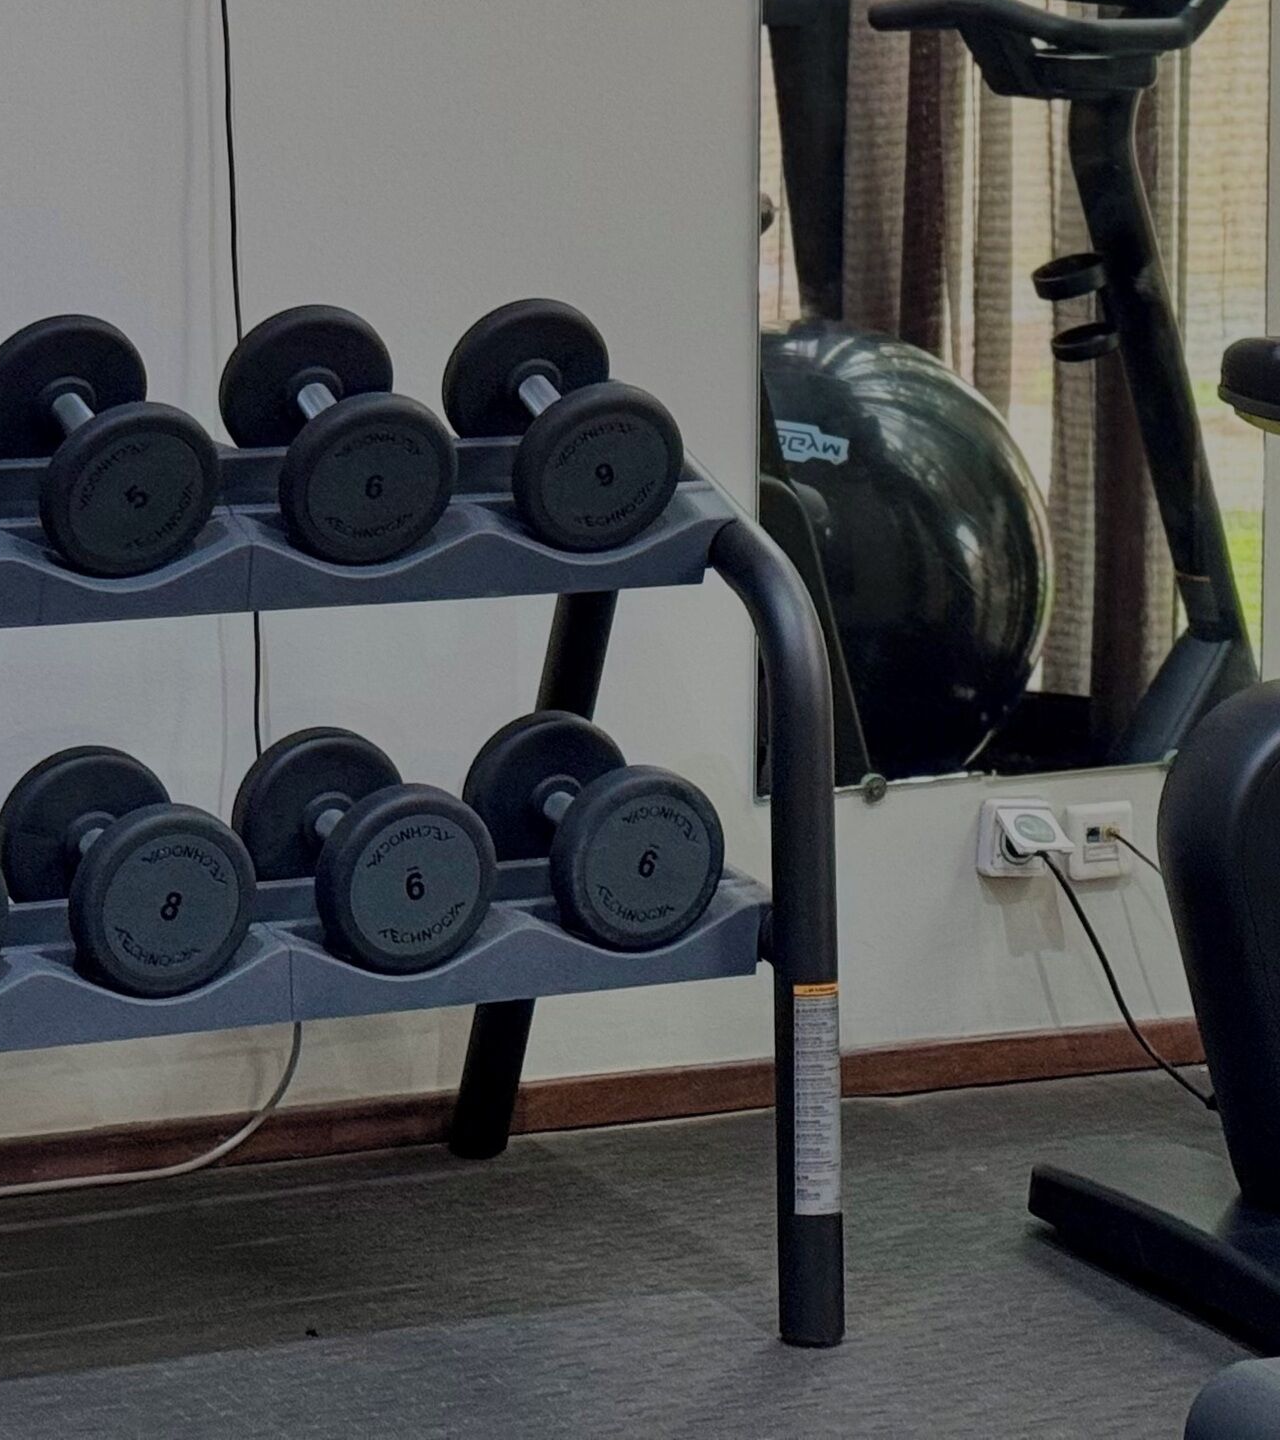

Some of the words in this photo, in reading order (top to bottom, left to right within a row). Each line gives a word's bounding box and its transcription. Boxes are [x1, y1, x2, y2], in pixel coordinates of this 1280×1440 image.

[124, 485, 149, 509] 5
[365, 474, 384, 500] 6
[366, 825, 456, 869] TECHNOGYM
[160, 891, 182, 921] 8
[378, 902, 466, 944] TECHNOGYM
